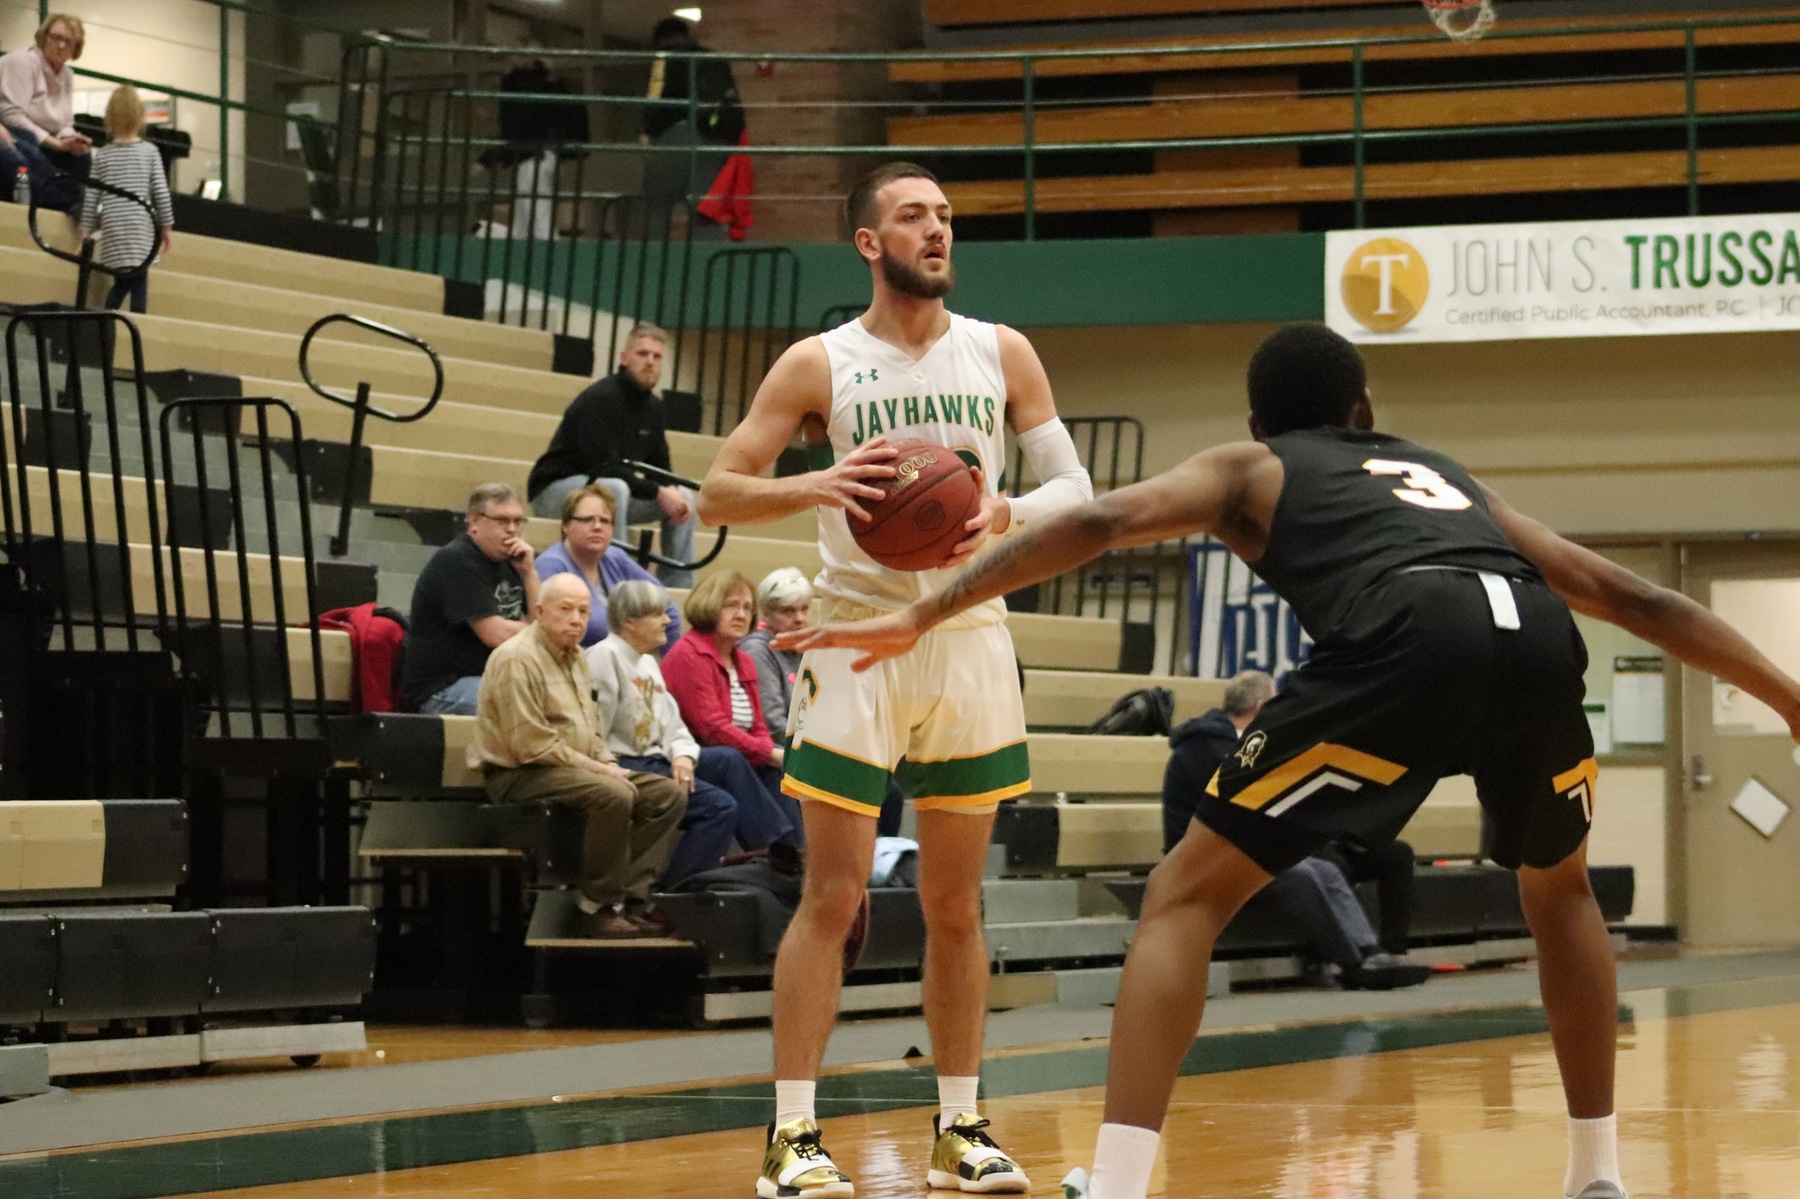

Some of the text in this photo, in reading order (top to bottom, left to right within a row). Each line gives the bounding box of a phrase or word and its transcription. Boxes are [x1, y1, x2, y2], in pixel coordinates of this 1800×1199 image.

[1360, 253, 1409, 316] T
[1447, 229, 1800, 297] JOHN S. TRUSSA
[1444, 305, 1525, 325] Certified
[1530, 304, 1591, 322] Public
[852, 394, 996, 446] JAYHAWKS
[1361, 458, 1473, 511] 3
